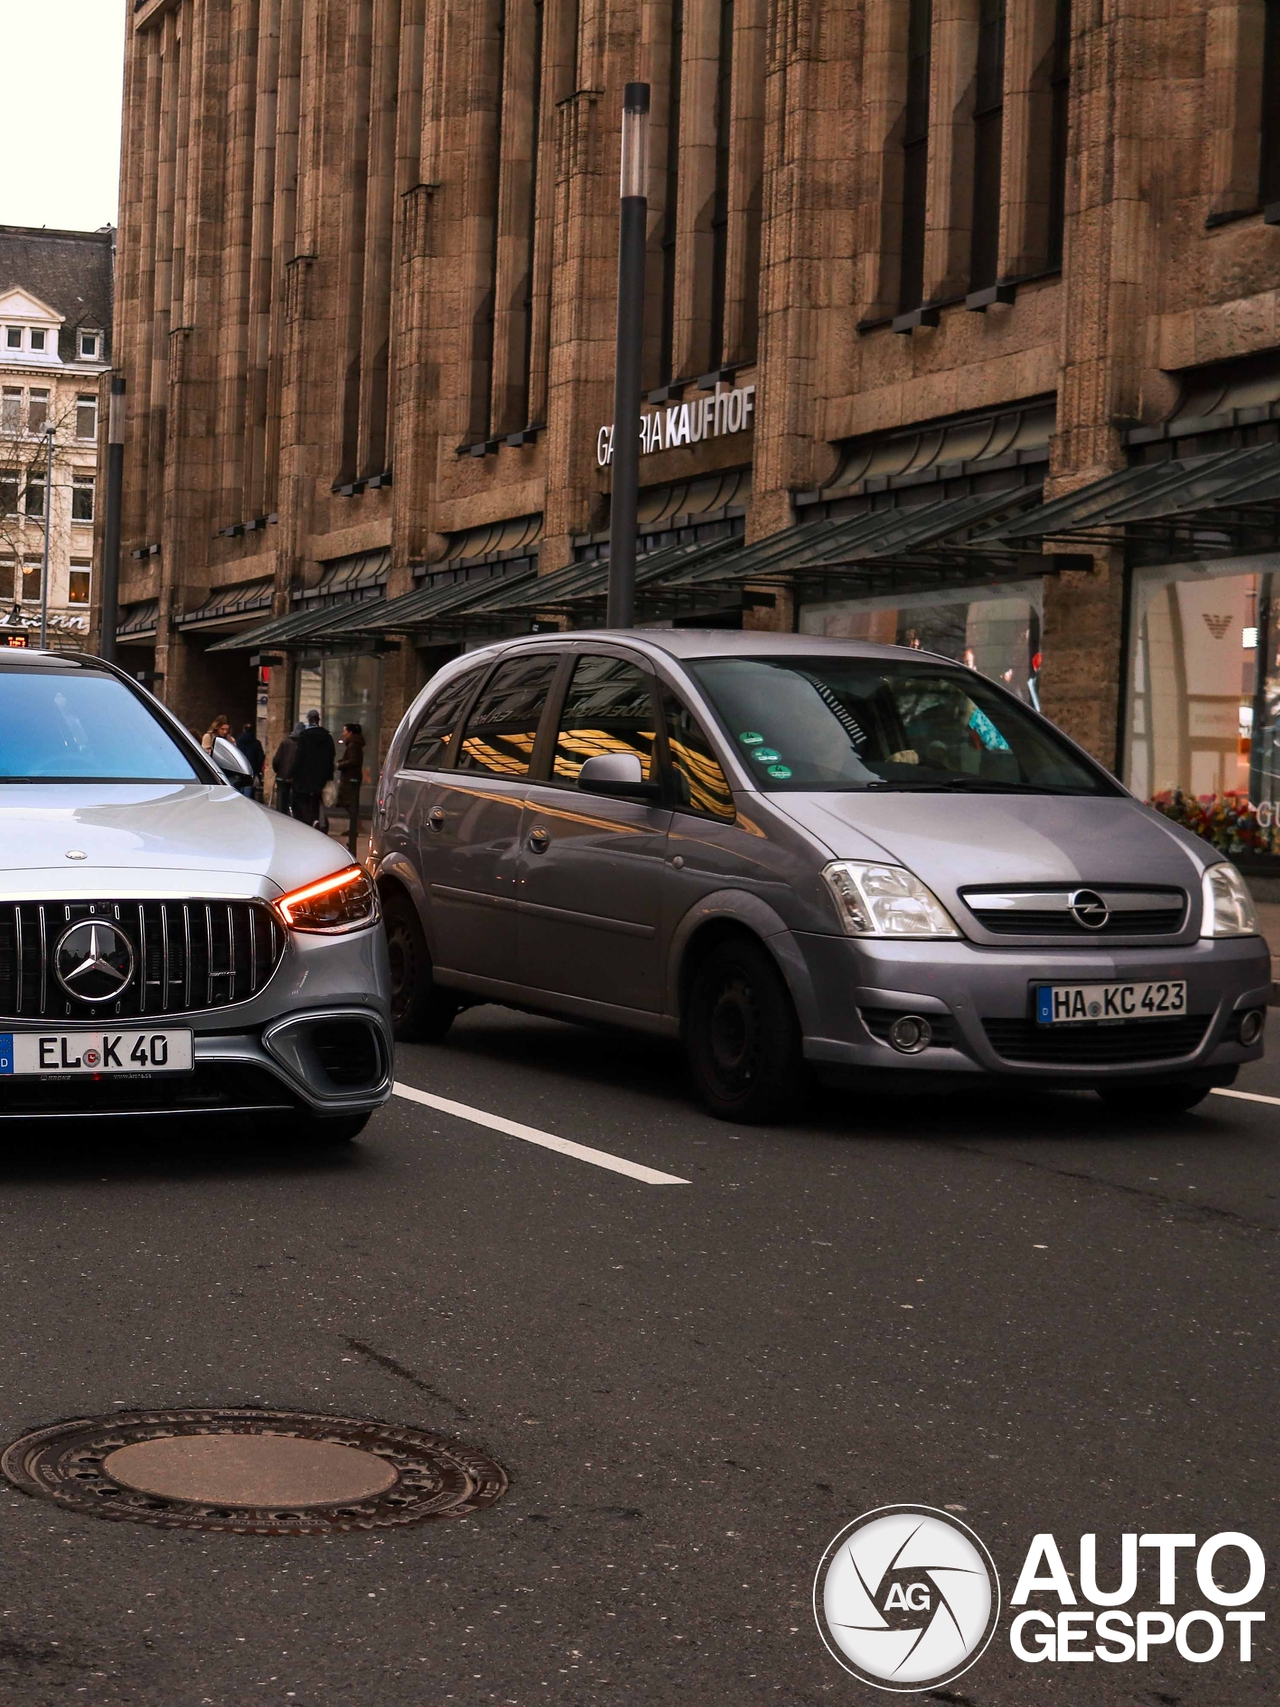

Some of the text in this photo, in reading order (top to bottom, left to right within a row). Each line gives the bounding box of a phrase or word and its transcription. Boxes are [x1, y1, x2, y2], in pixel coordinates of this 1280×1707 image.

[597, 411, 663, 467] GARIA
[1054, 983, 1185, 1019] HA KC 423
[0, 1058, 9, 1067] D
[38, 1034, 168, 1069] EL K 40
